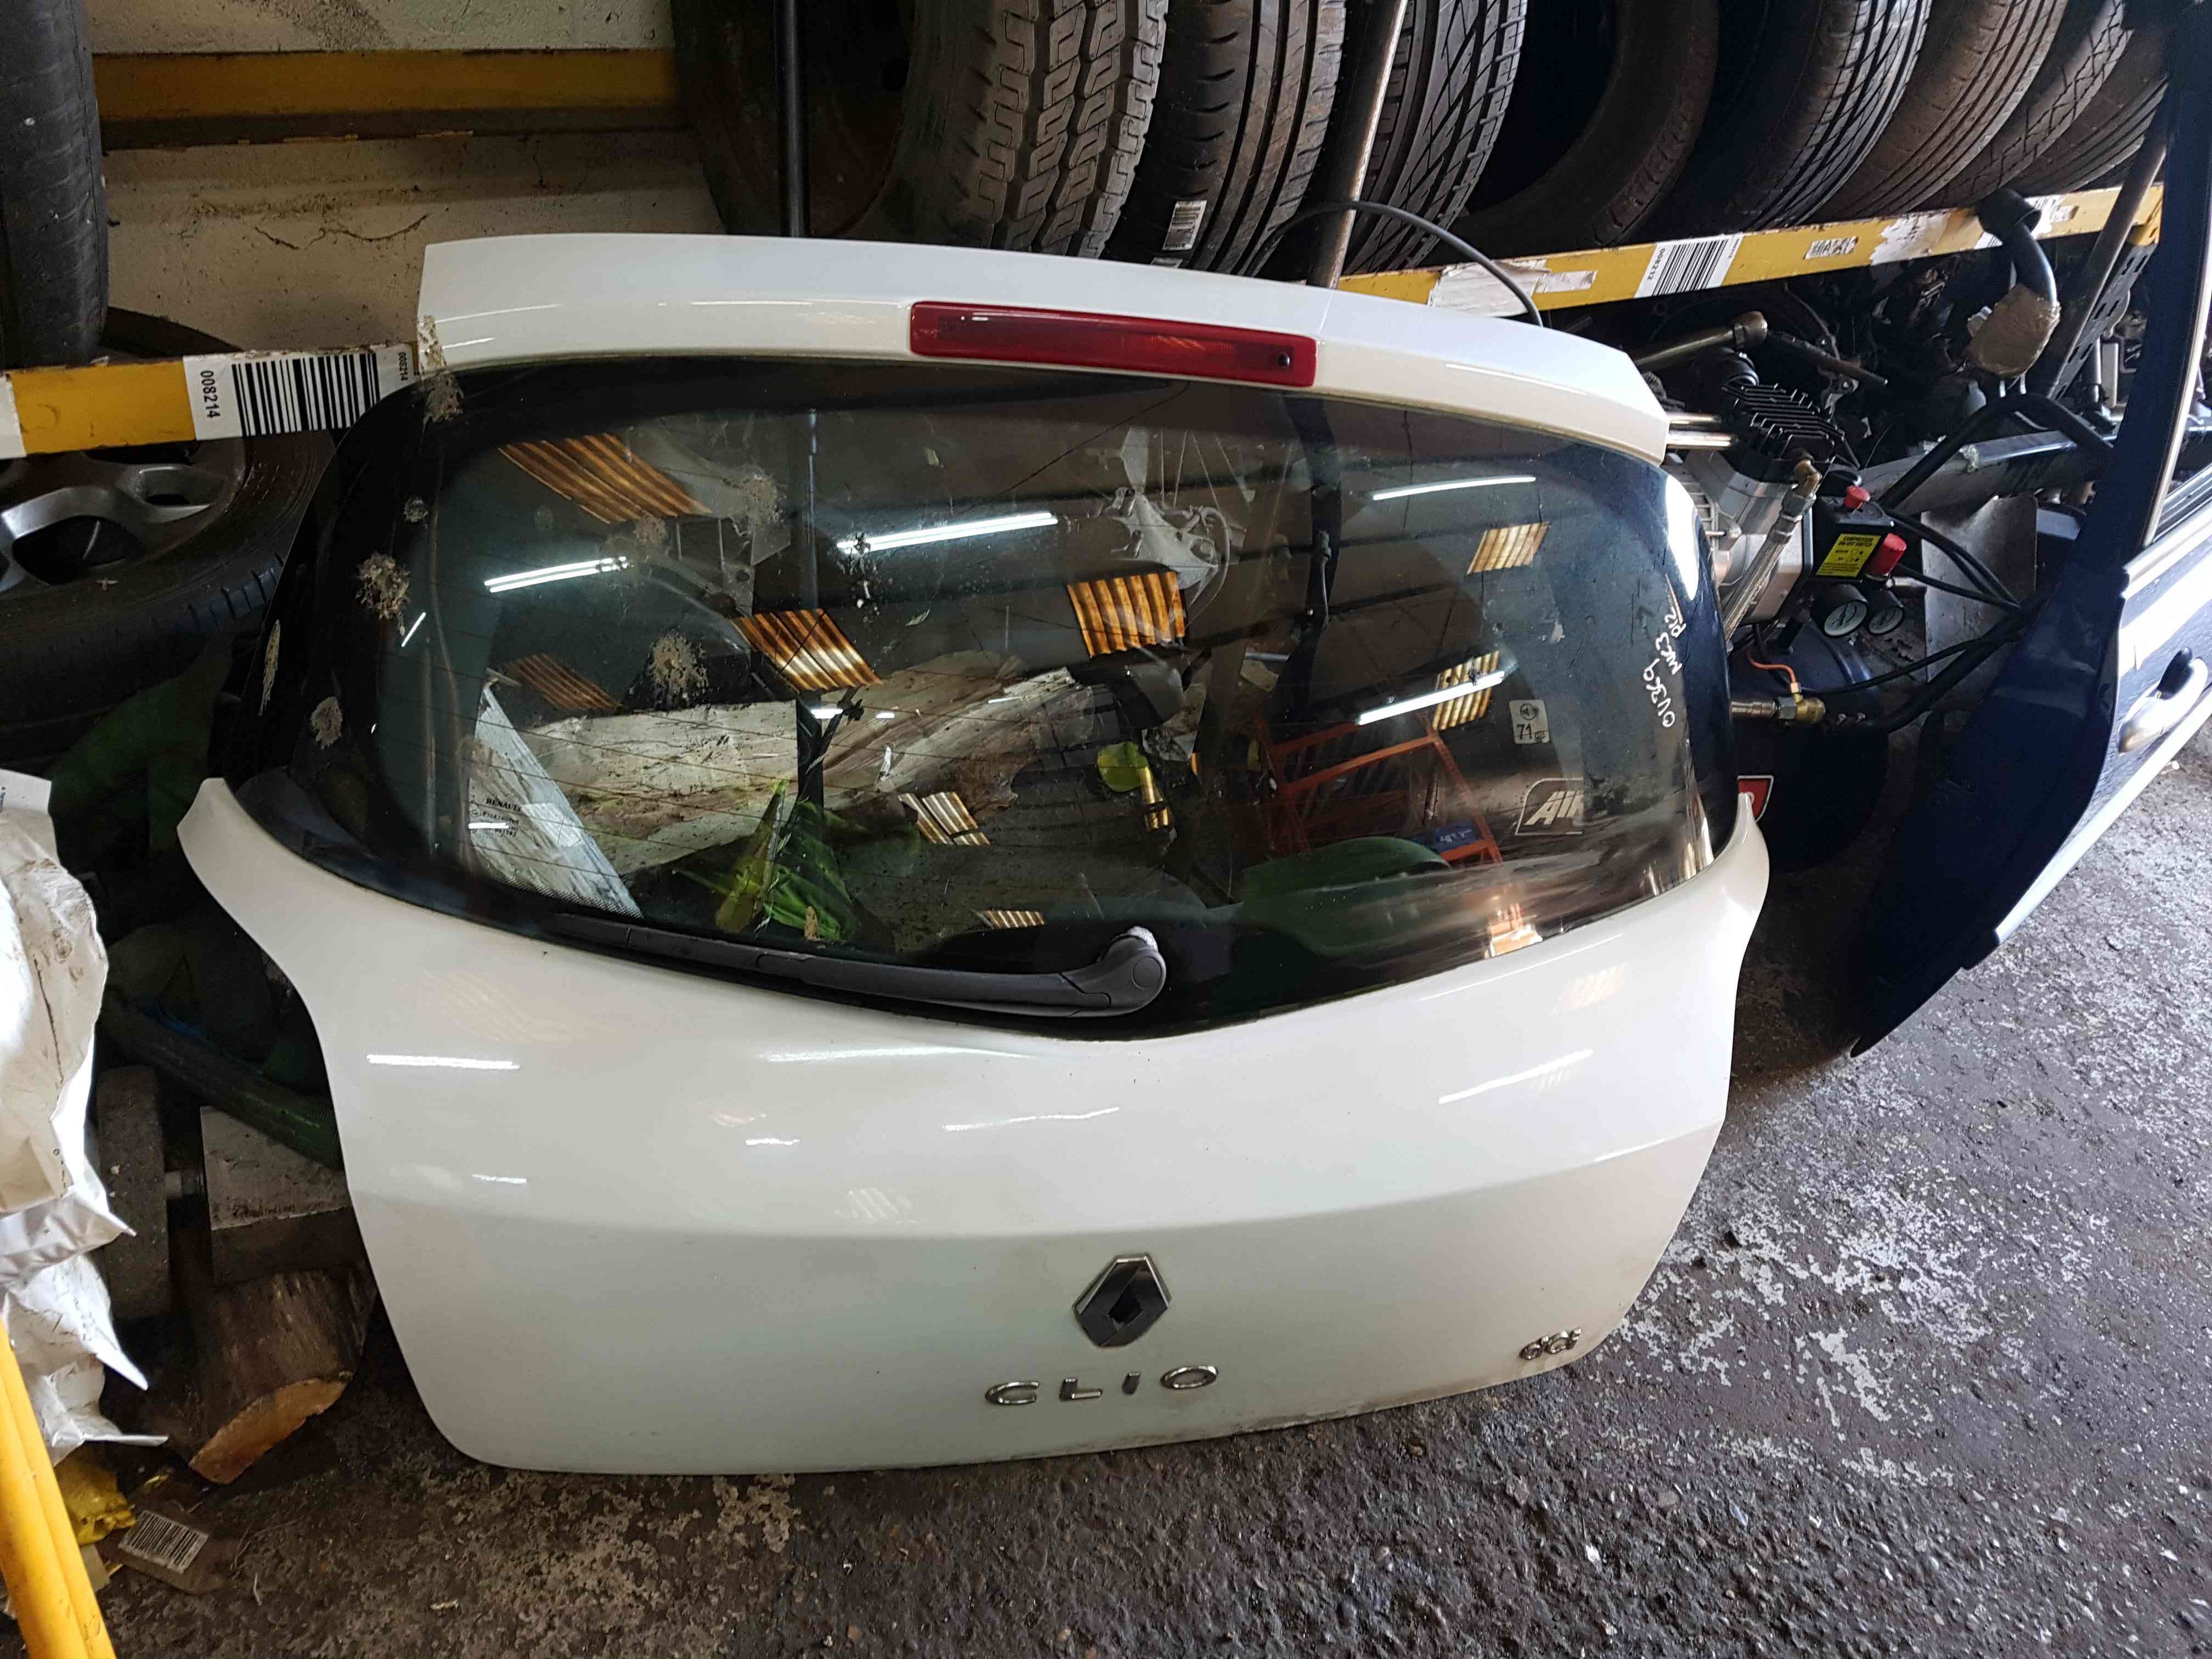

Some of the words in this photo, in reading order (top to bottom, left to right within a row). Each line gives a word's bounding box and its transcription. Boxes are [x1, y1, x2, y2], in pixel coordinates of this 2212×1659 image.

[1647, 247, 1666, 281] 008212
[200, 370, 221, 419] 008214
[1655, 631, 1683, 675] MK3
[1516, 723, 1533, 740] 71
[985, 1365, 1218, 1406] CLIO
